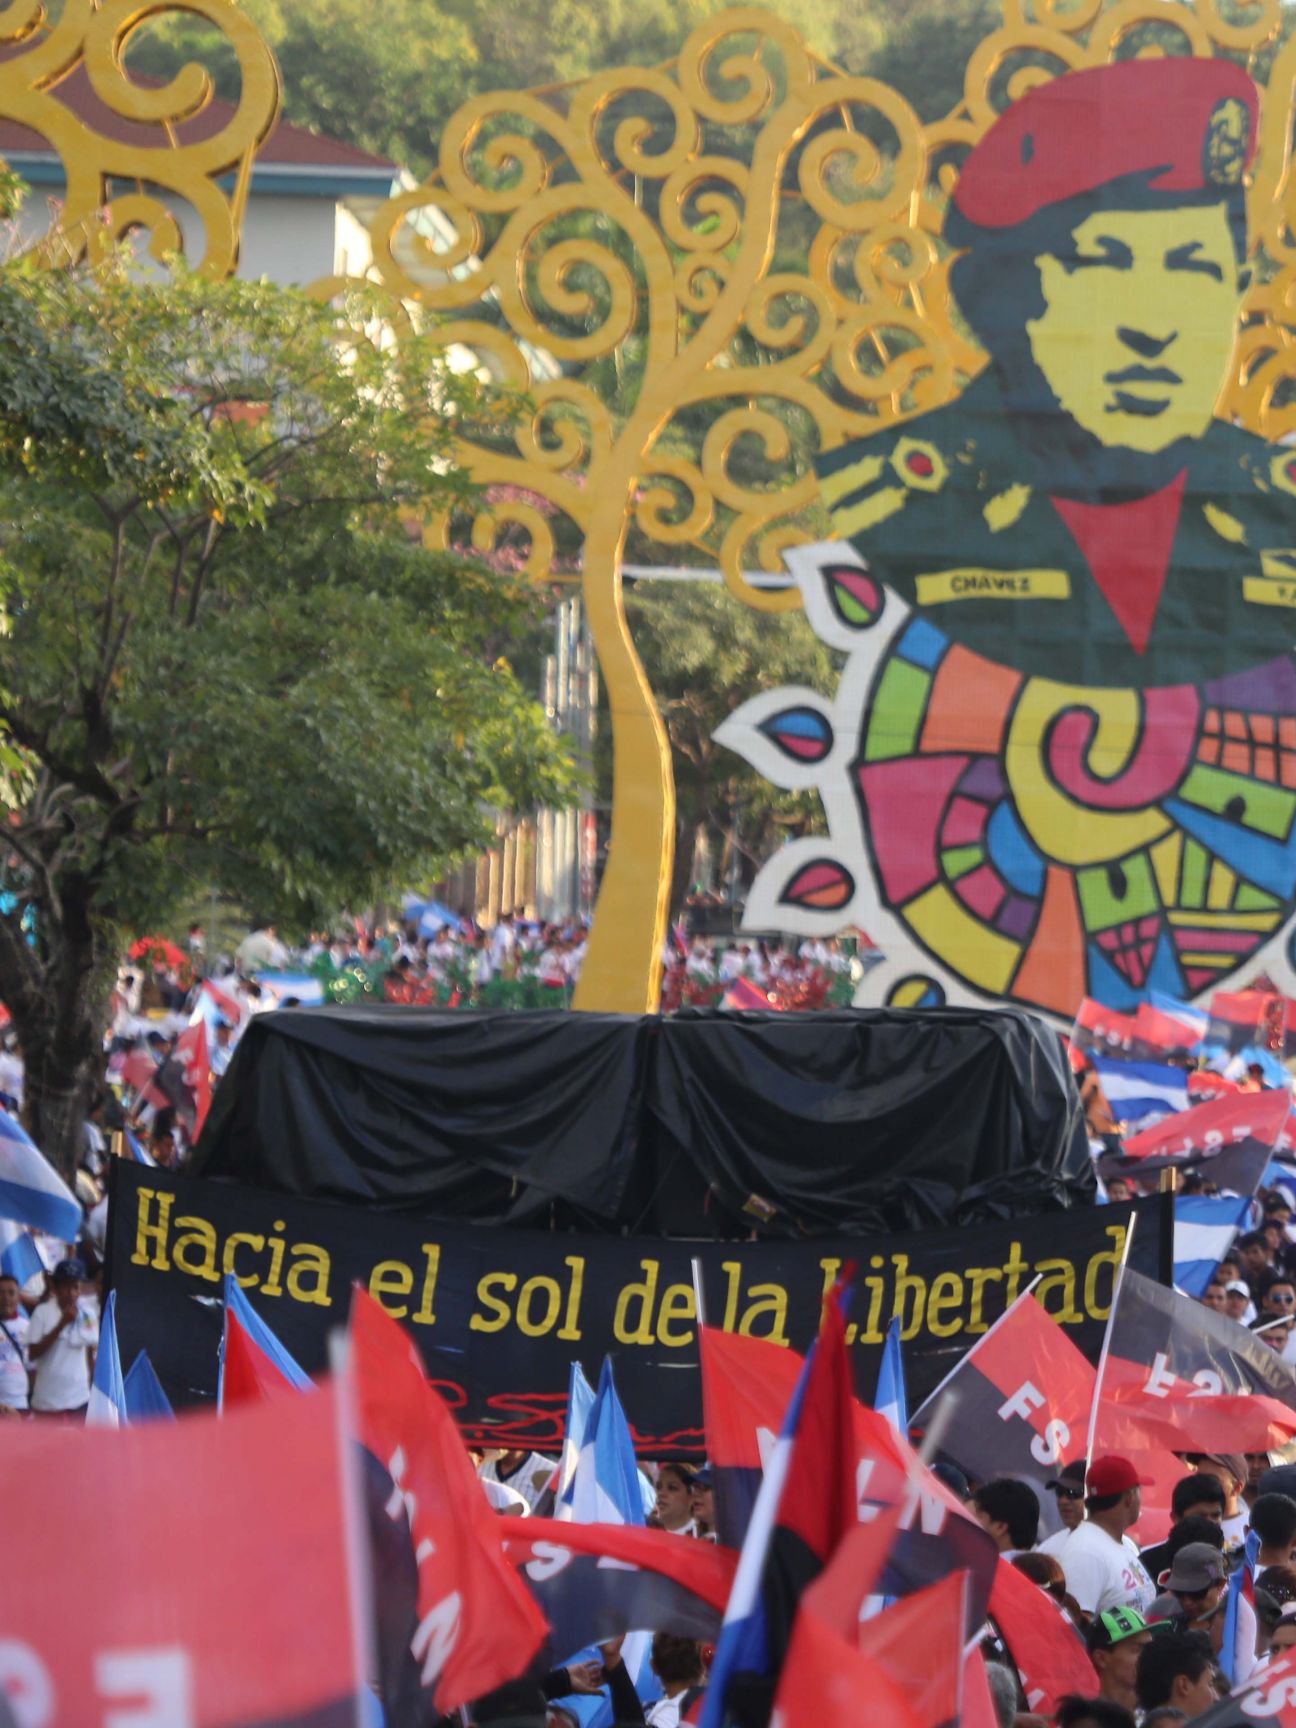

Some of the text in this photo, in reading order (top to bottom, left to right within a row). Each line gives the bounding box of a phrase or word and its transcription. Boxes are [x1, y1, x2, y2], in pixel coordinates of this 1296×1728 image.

[130, 1187, 1127, 1348] Hacia el sol de la Libertad
[998, 1380, 1071, 1466] FS
